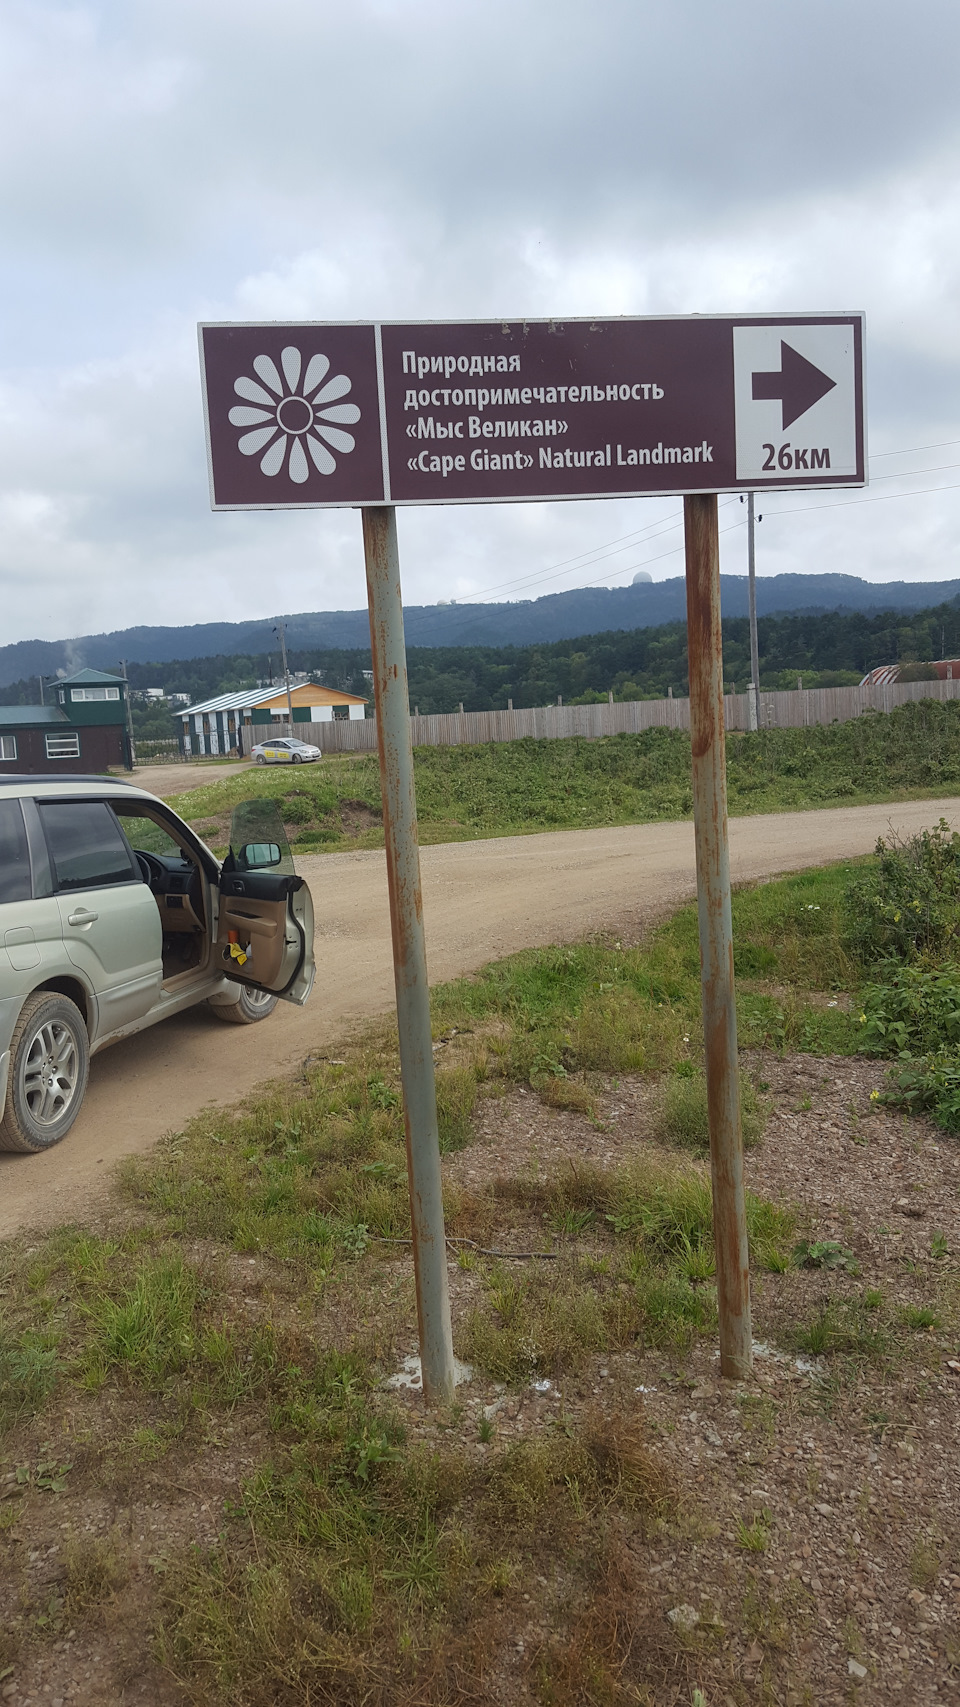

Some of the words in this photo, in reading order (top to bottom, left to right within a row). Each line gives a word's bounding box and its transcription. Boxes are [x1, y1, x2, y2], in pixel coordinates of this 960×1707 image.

[402, 350, 521, 379] Природная
[403, 383, 665, 411] достопримечательность
[405, 417, 464, 439] «Мыс
[468, 416, 569, 439] Великан»
[407, 450, 466, 478] «Cape
[470, 448, 534, 471] Giant»
[538, 444, 612, 469] Natural
[616, 440, 714, 467] Landmark
[761, 442, 831, 471] 26км
